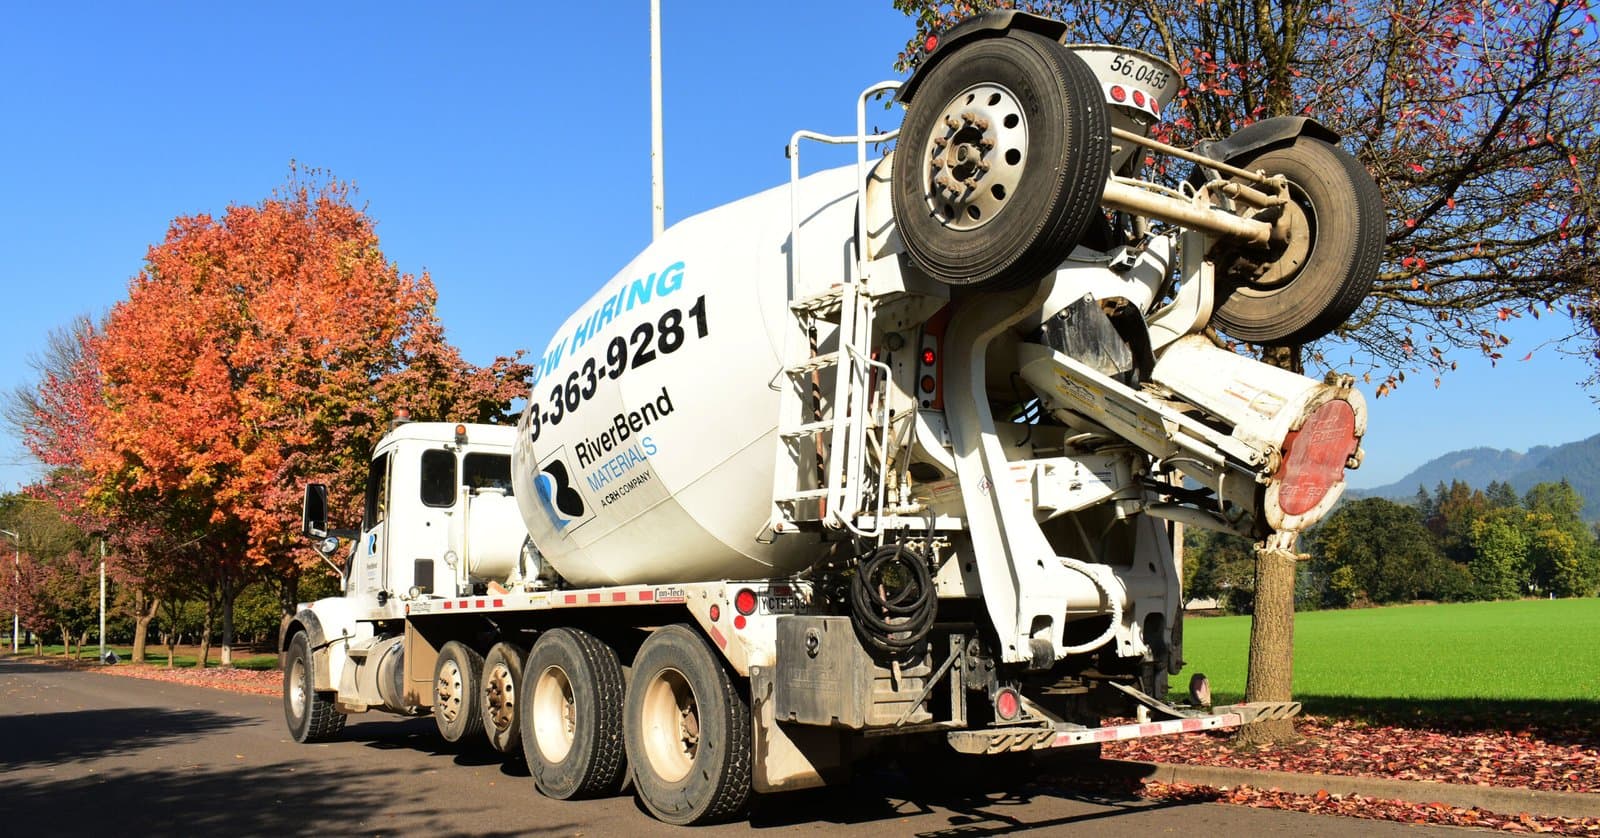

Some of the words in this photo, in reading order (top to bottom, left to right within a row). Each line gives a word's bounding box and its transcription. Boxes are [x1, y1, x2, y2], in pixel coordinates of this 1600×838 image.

[1110, 55, 1170, 90] 56.0455
[570, 261, 685, 356] HIRING
[574, 386, 675, 469] RiverBend
[586, 436, 658, 493] MATERIALS
[600, 499, 608, 509] A
[604, 489, 621, 506] CRH
[620, 470, 652, 497] COMPANY
